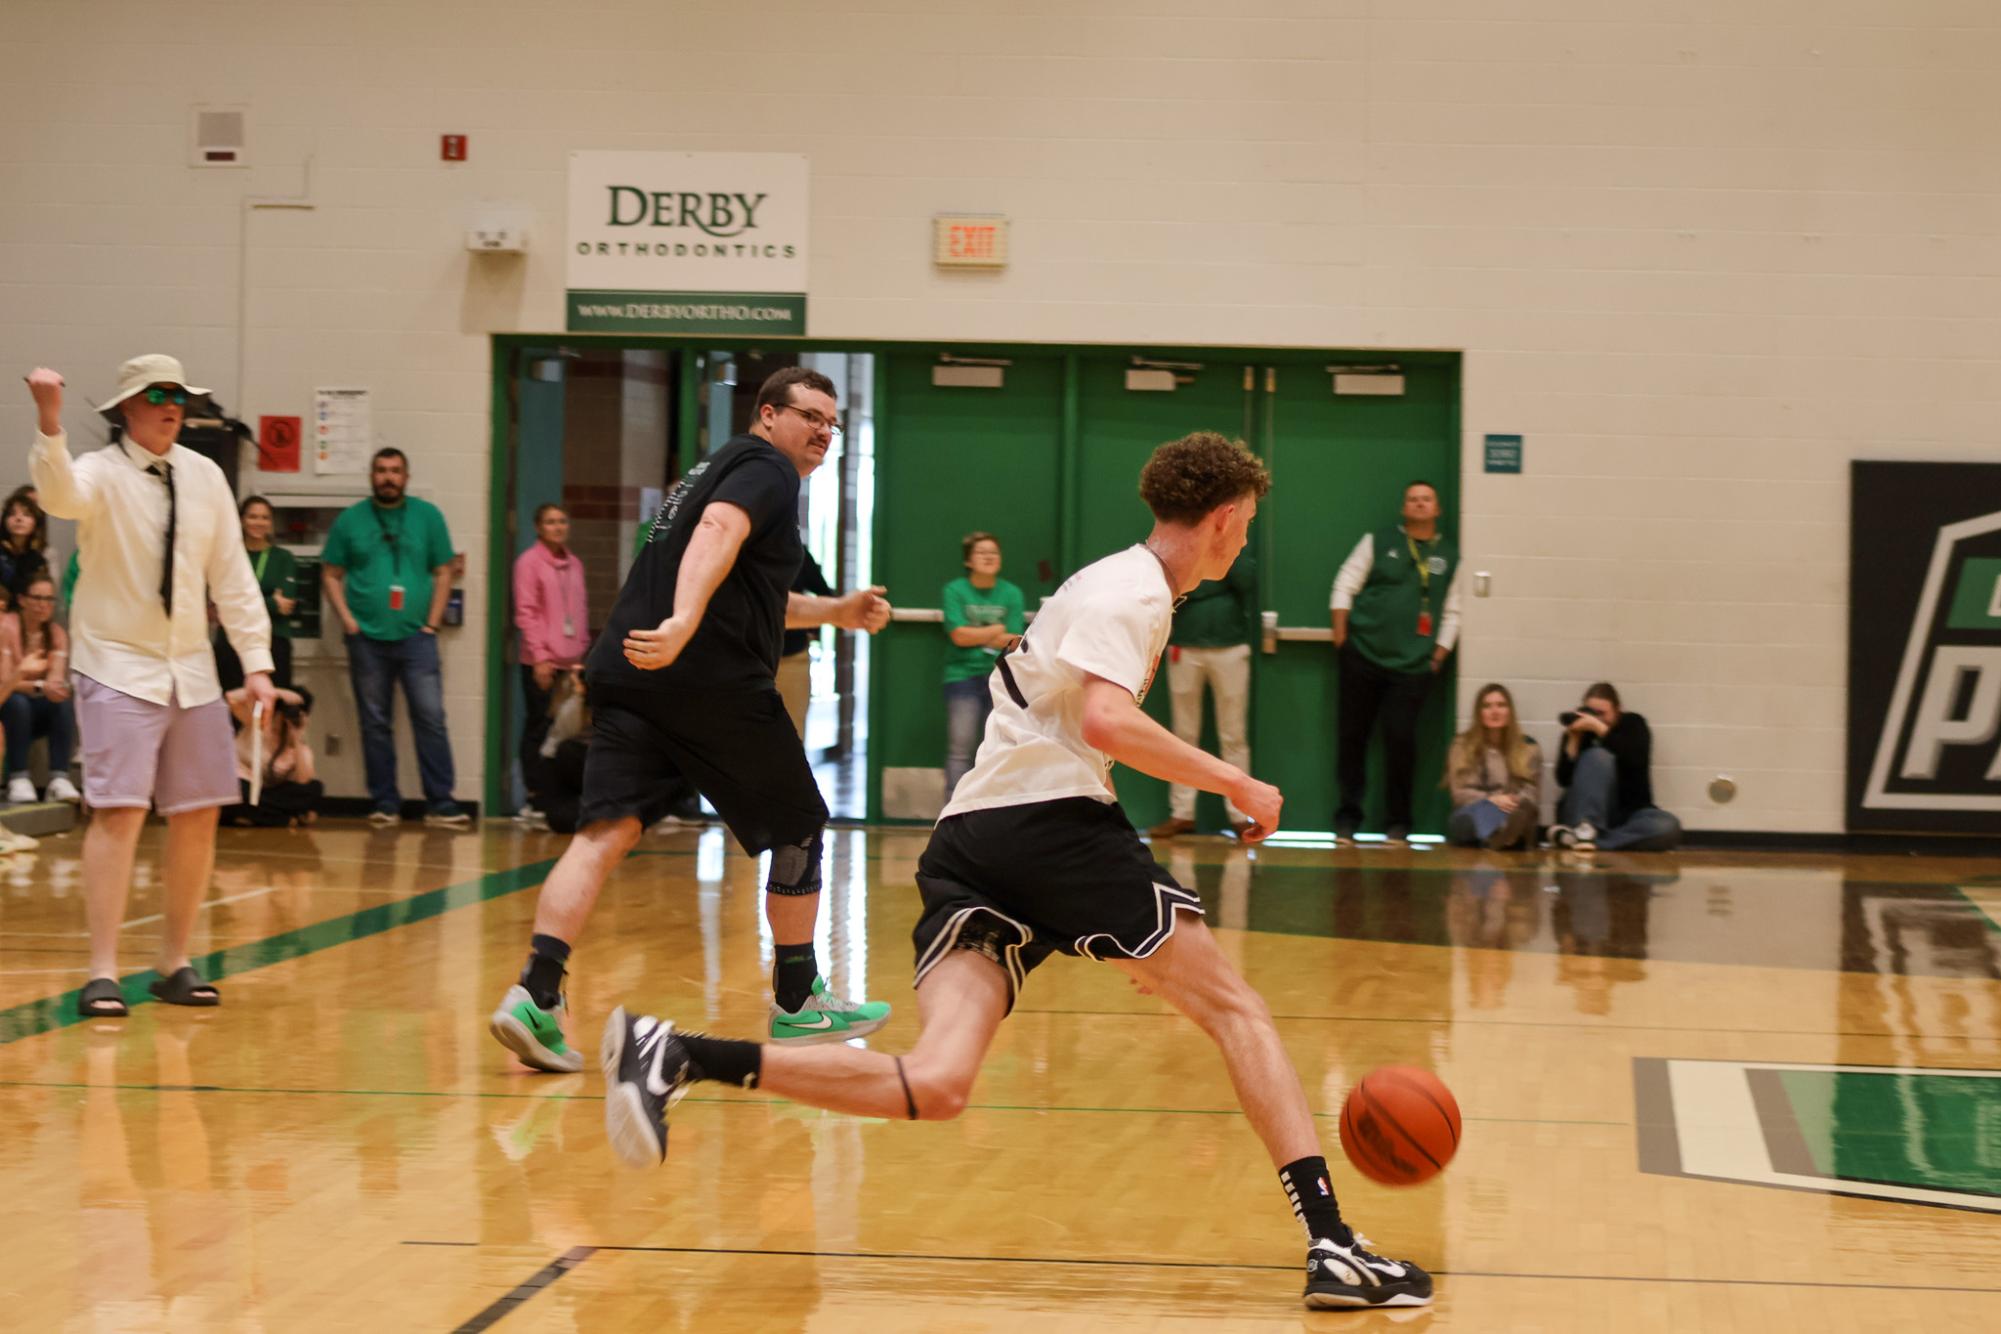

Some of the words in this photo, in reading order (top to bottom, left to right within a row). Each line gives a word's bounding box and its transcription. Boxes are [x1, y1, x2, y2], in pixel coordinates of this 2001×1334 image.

[606, 185, 767, 237] DERBY
[577, 242, 796, 258] ORTHODONTICS
[950, 225, 996, 257] EXIT
